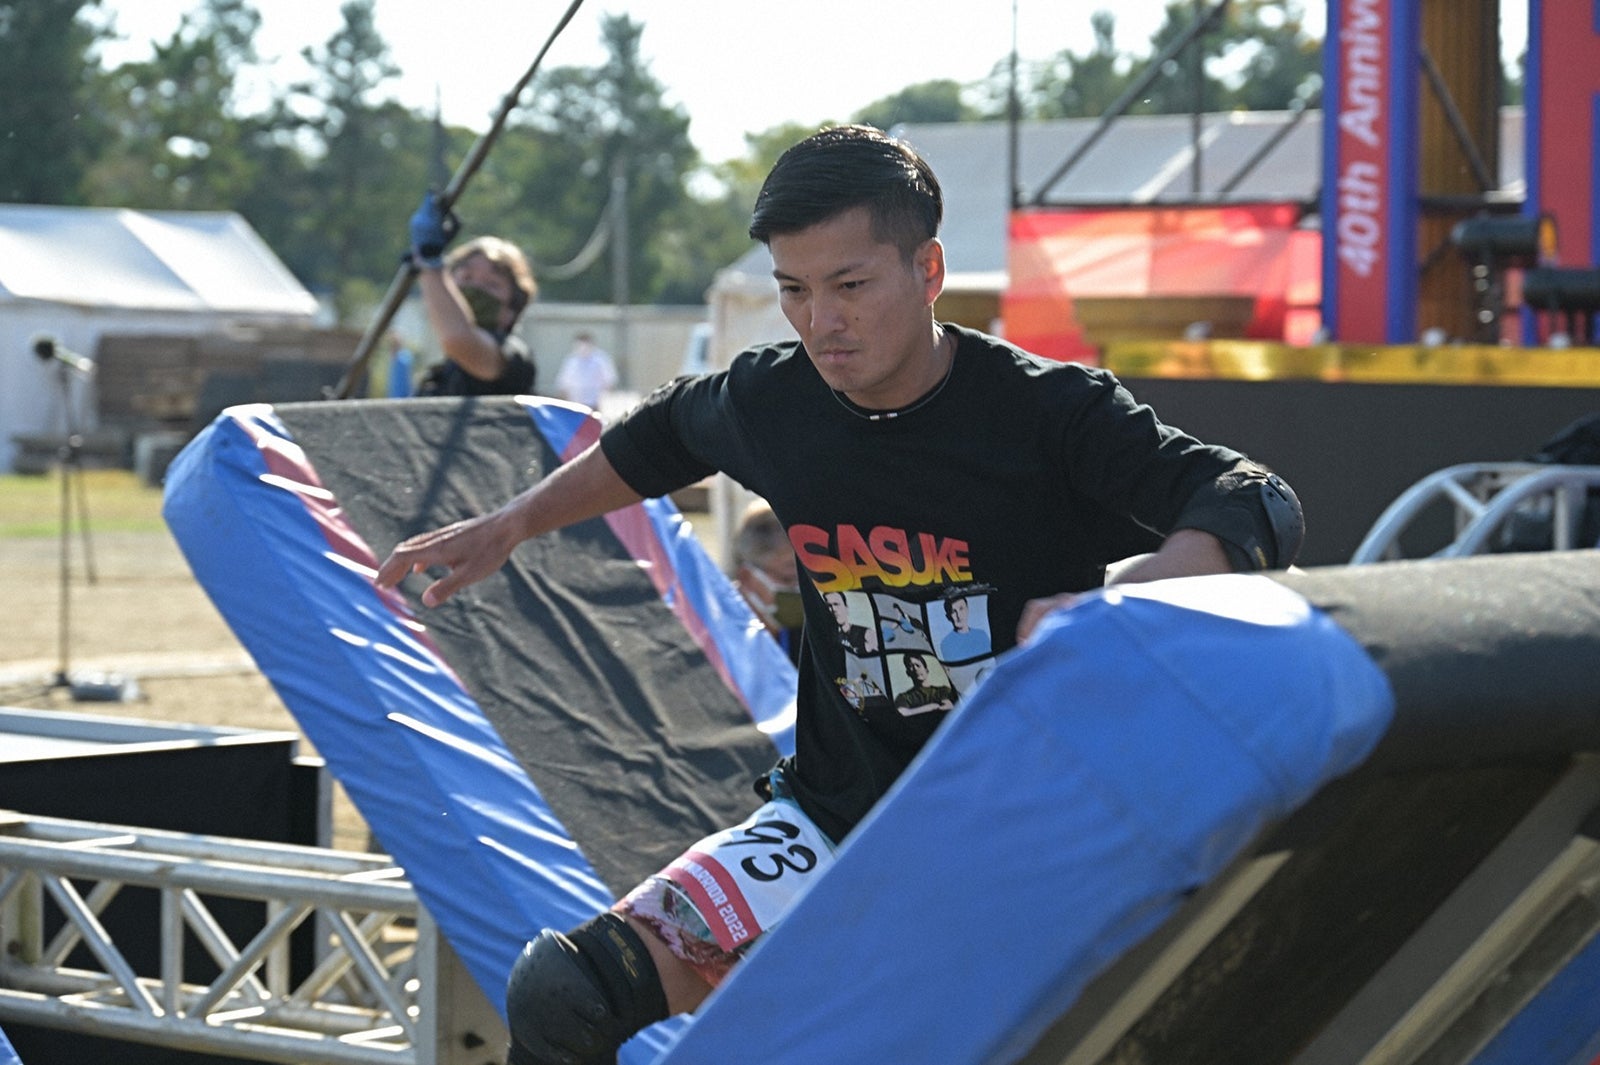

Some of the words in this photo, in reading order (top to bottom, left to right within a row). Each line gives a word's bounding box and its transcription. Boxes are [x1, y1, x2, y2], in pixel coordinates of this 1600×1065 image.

[1338, 0, 1381, 147] Anniv
[1338, 161, 1381, 277] 40th
[788, 524, 973, 592] SASUKE
[719, 820, 817, 882] 93
[718, 903, 748, 943] 2022
